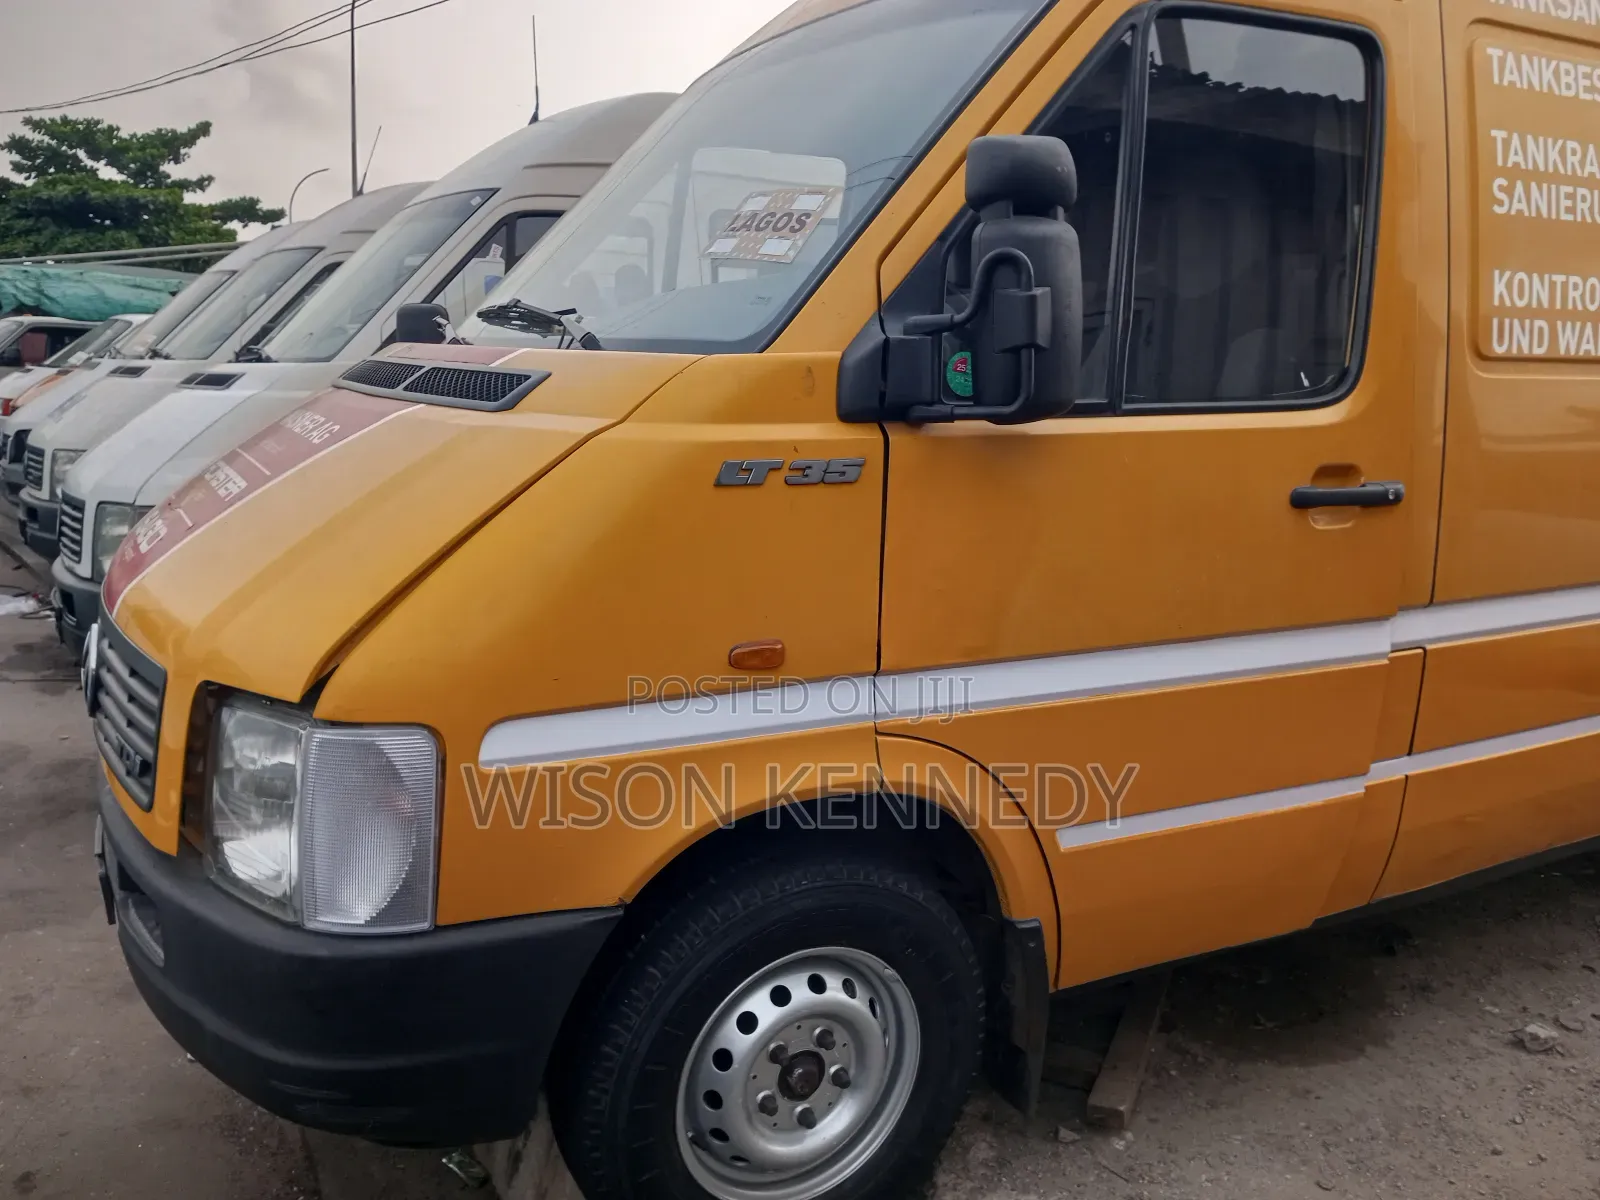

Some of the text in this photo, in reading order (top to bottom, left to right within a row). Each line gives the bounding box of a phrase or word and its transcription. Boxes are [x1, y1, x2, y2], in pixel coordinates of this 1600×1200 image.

[1490, 129, 1600, 179] TANKRA
[724, 211, 812, 234] LAGOS
[1493, 269, 1600, 312] KONTRO
[1492, 317, 1600, 356] UND WA
[713, 458, 866, 486] LT 35
